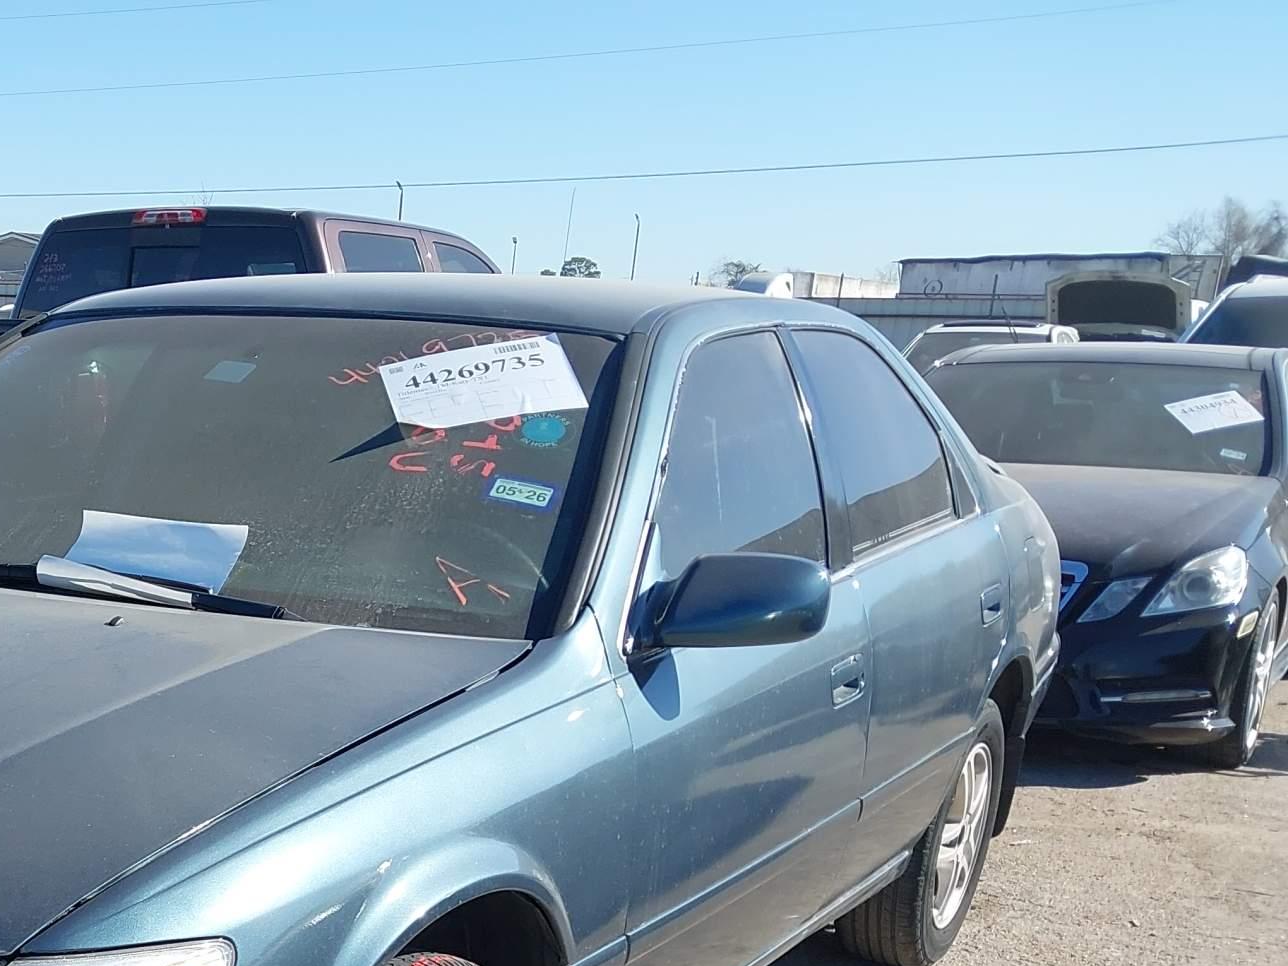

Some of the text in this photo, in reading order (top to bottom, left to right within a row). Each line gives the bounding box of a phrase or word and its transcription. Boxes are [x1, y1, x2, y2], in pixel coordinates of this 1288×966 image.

[405, 353, 545, 389] 44269735
[495, 484, 548, 502] 05 26
